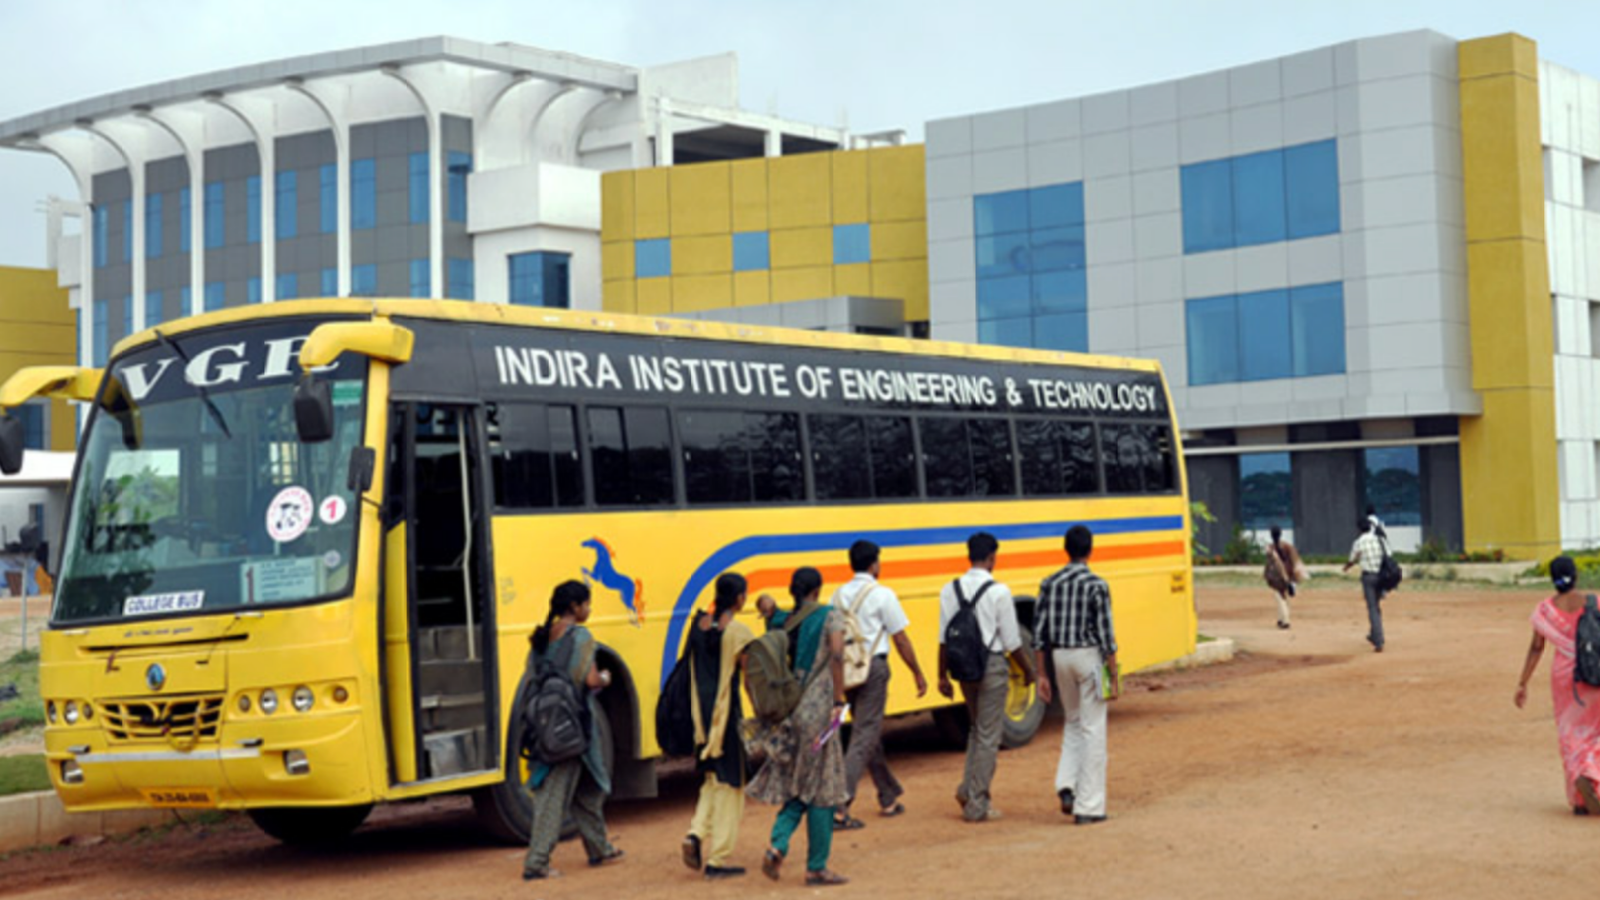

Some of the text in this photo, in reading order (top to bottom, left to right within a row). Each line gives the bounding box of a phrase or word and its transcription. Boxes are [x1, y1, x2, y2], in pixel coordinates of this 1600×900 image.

[495, 346, 1156, 411] INDIRA INSTITUTE OF ENGINEERING & TECHNOLOGY
[325, 500, 337, 519] 1
[128, 593, 200, 612] COLLEGE BUS
